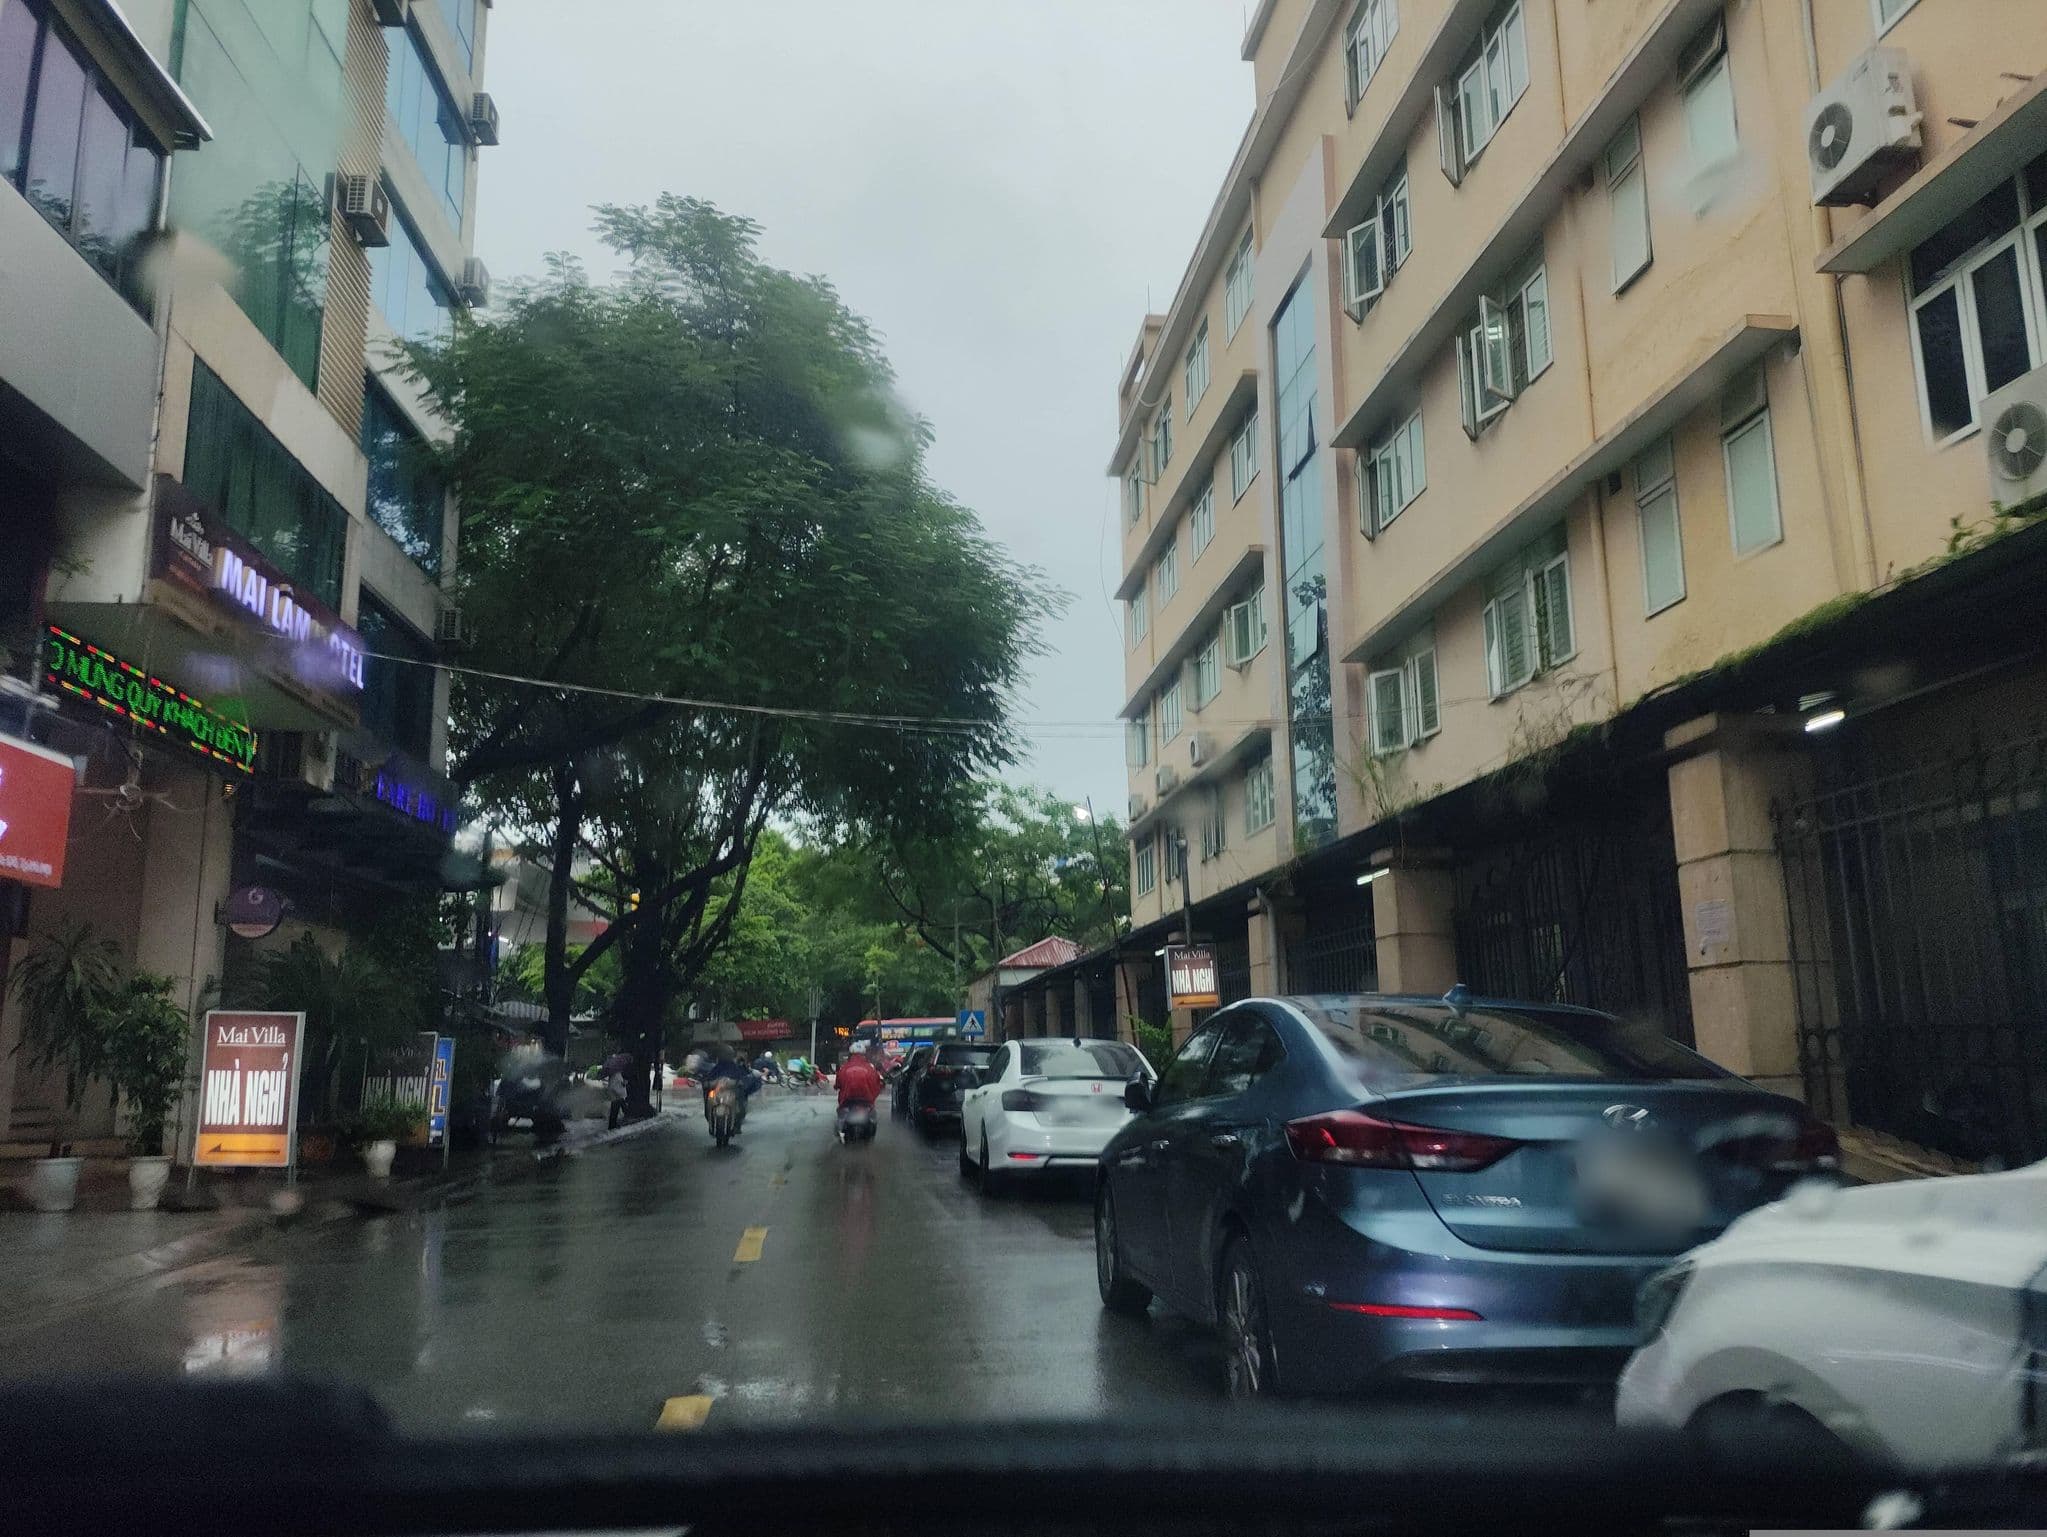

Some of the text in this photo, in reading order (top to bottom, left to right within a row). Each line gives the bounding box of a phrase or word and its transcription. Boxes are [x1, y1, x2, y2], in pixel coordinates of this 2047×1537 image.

[221, 549, 267, 617] MAI
[1174, 949, 1211, 960] Mai Villa
[1172, 964, 1192, 993] NHÀ
[217, 1026, 286, 1044] Mai Villa
[205, 1052, 288, 1126] NHÀ NGHỈ
